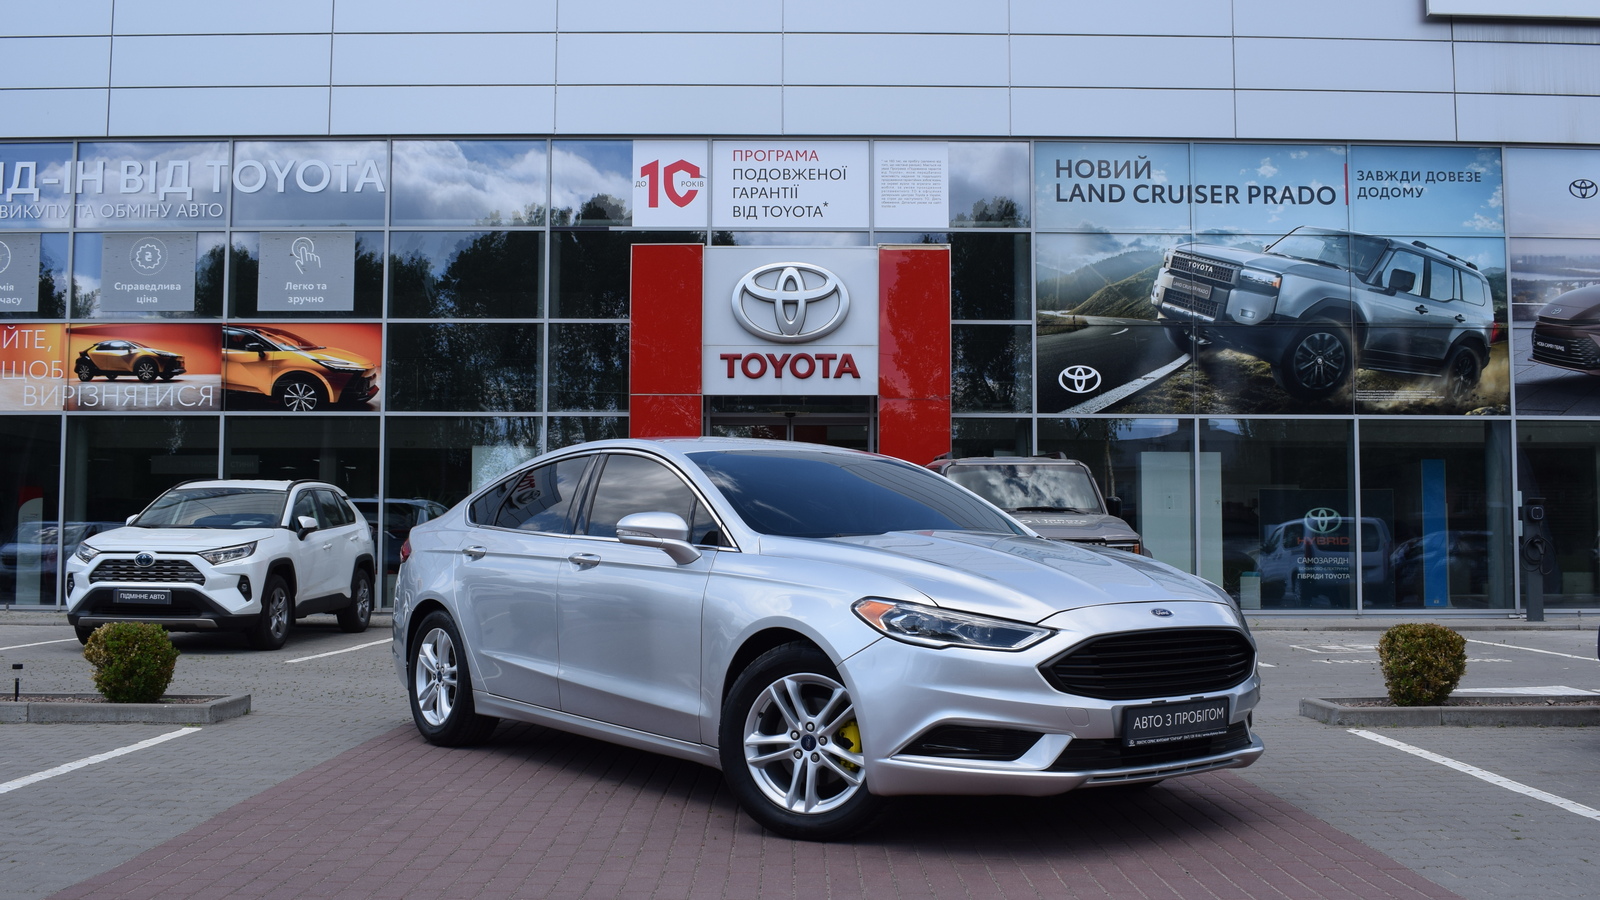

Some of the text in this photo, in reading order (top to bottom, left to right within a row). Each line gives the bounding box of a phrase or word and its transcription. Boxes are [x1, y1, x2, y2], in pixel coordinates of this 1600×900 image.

[732, 150, 819, 162] ПРОГРАМА
[732, 166, 848, 182] ПОДОВЖЕНОЇ
[1055, 155, 1152, 180] НОВИЙ
[0, 160, 386, 202] Д-ІН ВІД TOYOTA
[1357, 170, 1482, 184] ЗАВЖДИ ДОВЕЗЕ
[732, 184, 798, 199] ГАРАНТІЇ
[1055, 184, 1337, 206] LAND CRUISER PRADO
[1357, 186, 1424, 200] ДОДОМУ
[0, 202, 224, 219] ВИКУПУ ТА ОБМІНУ АВТО
[732, 206, 758, 220] ВІД
[1188, 261, 1213, 273] TOYOTA
[114, 282, 182, 293] Справедлива
[285, 281, 327, 292] Легко та
[136, 294, 158, 306] ціна
[288, 296, 324, 305] зручно
[3, 326, 52, 352] ЙТЕ,
[2, 360, 64, 383] ЩОБ
[720, 353, 861, 379] TOYOTA
[24, 385, 213, 407] ВИРІЗНЯТИСЯ
[1297, 536, 1350, 545] HYBRID
[1133, 714, 1163, 730] АВТО
[1174, 707, 1224, 726] ПРОБІГОМ
